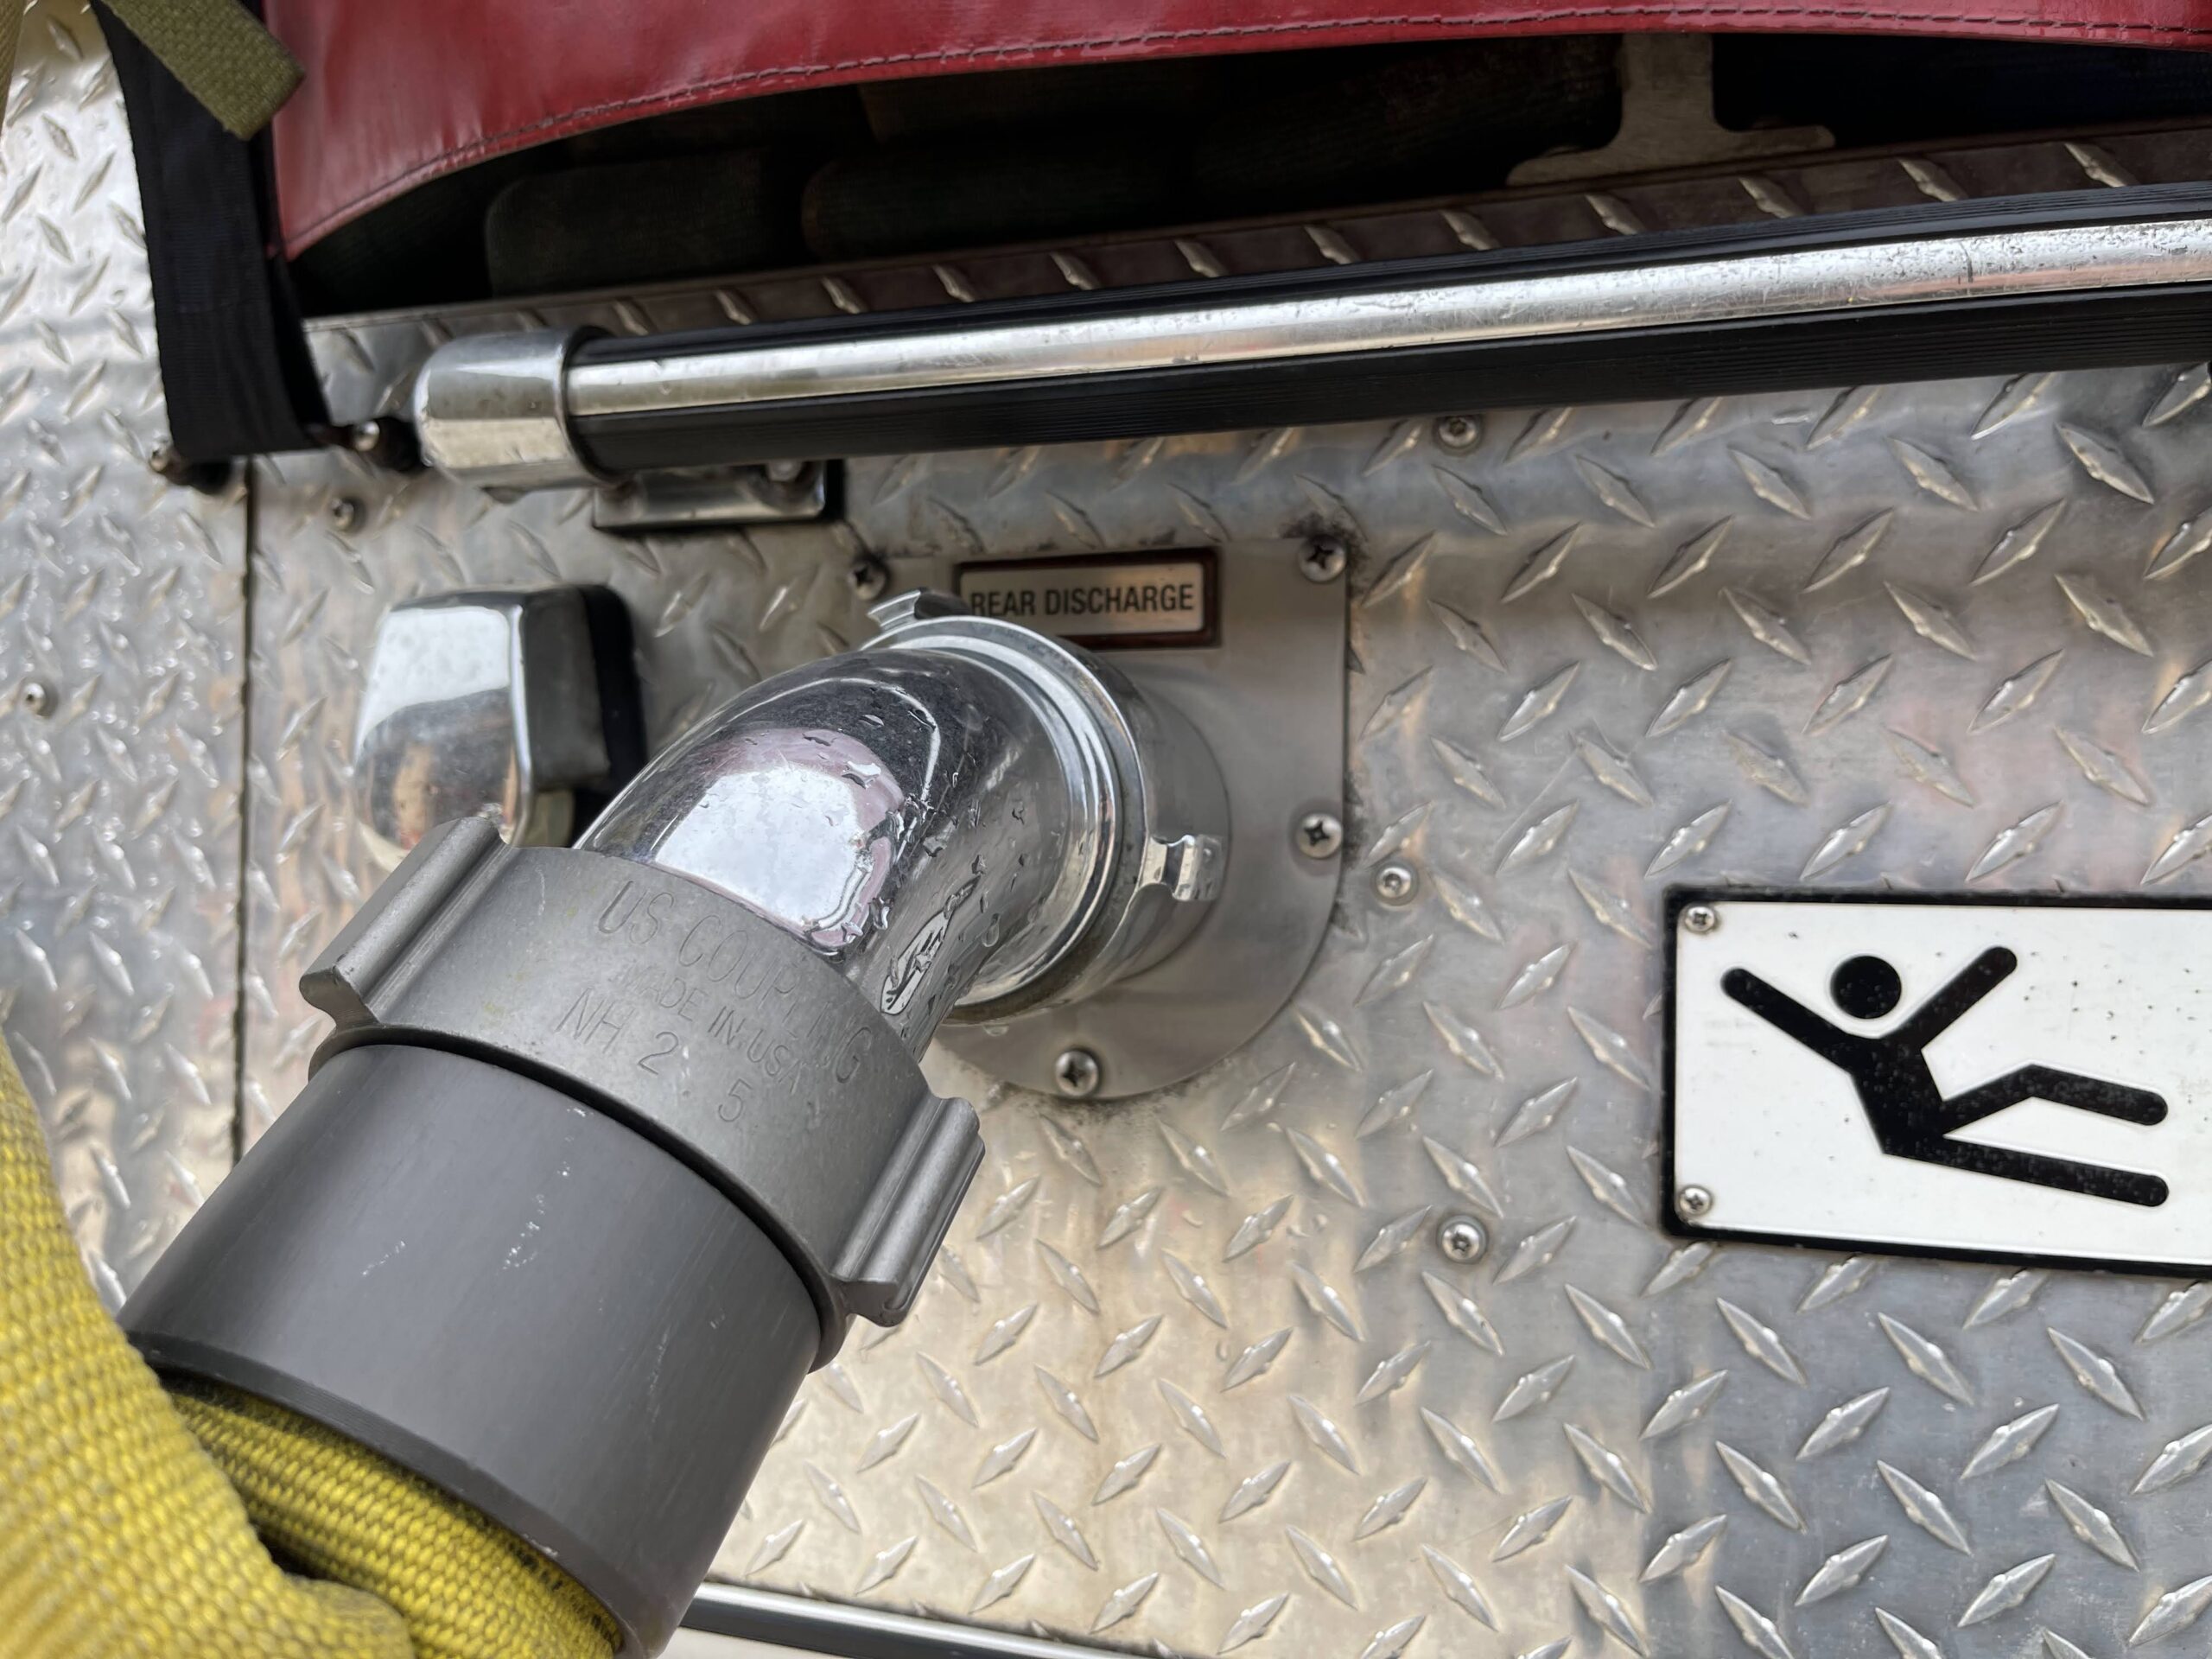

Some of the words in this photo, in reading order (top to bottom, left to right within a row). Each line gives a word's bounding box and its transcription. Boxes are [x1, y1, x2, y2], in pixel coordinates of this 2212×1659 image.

[969, 590, 1035, 618] REAR
[1045, 583, 1194, 615] DISCHARGE
[597, 879, 676, 945] US
[677, 914, 873, 1084] COUPLING
[554, 987, 636, 1054] NH
